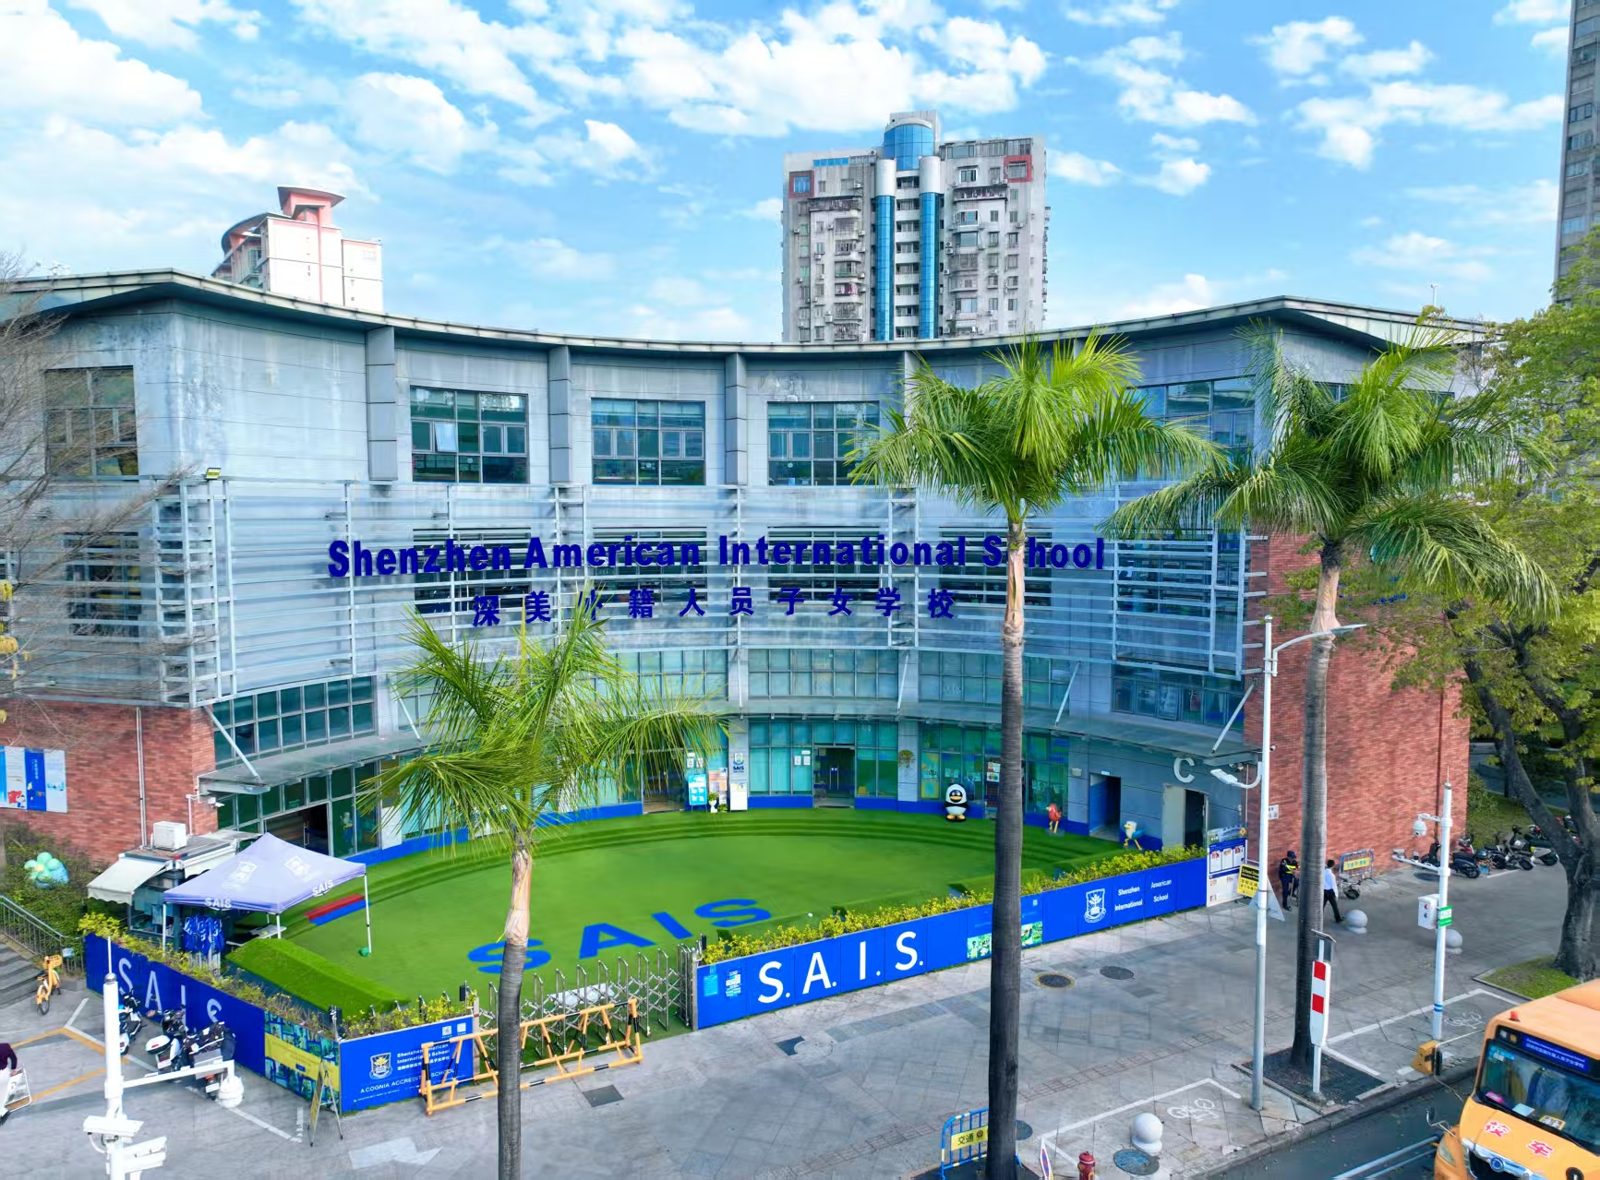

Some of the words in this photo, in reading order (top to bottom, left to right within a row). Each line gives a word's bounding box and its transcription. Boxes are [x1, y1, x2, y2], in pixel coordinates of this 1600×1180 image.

[328, 539, 510, 577] Shenzhen
[523, 536, 700, 569] American
[719, 534, 966, 567] International
[982, 535, 1104, 570] Shool
[1173, 757, 1195, 783] C
[312, 880, 334, 896] SAIS
[205, 897, 232, 909] SAIS
[1153, 893, 1169, 903] School
